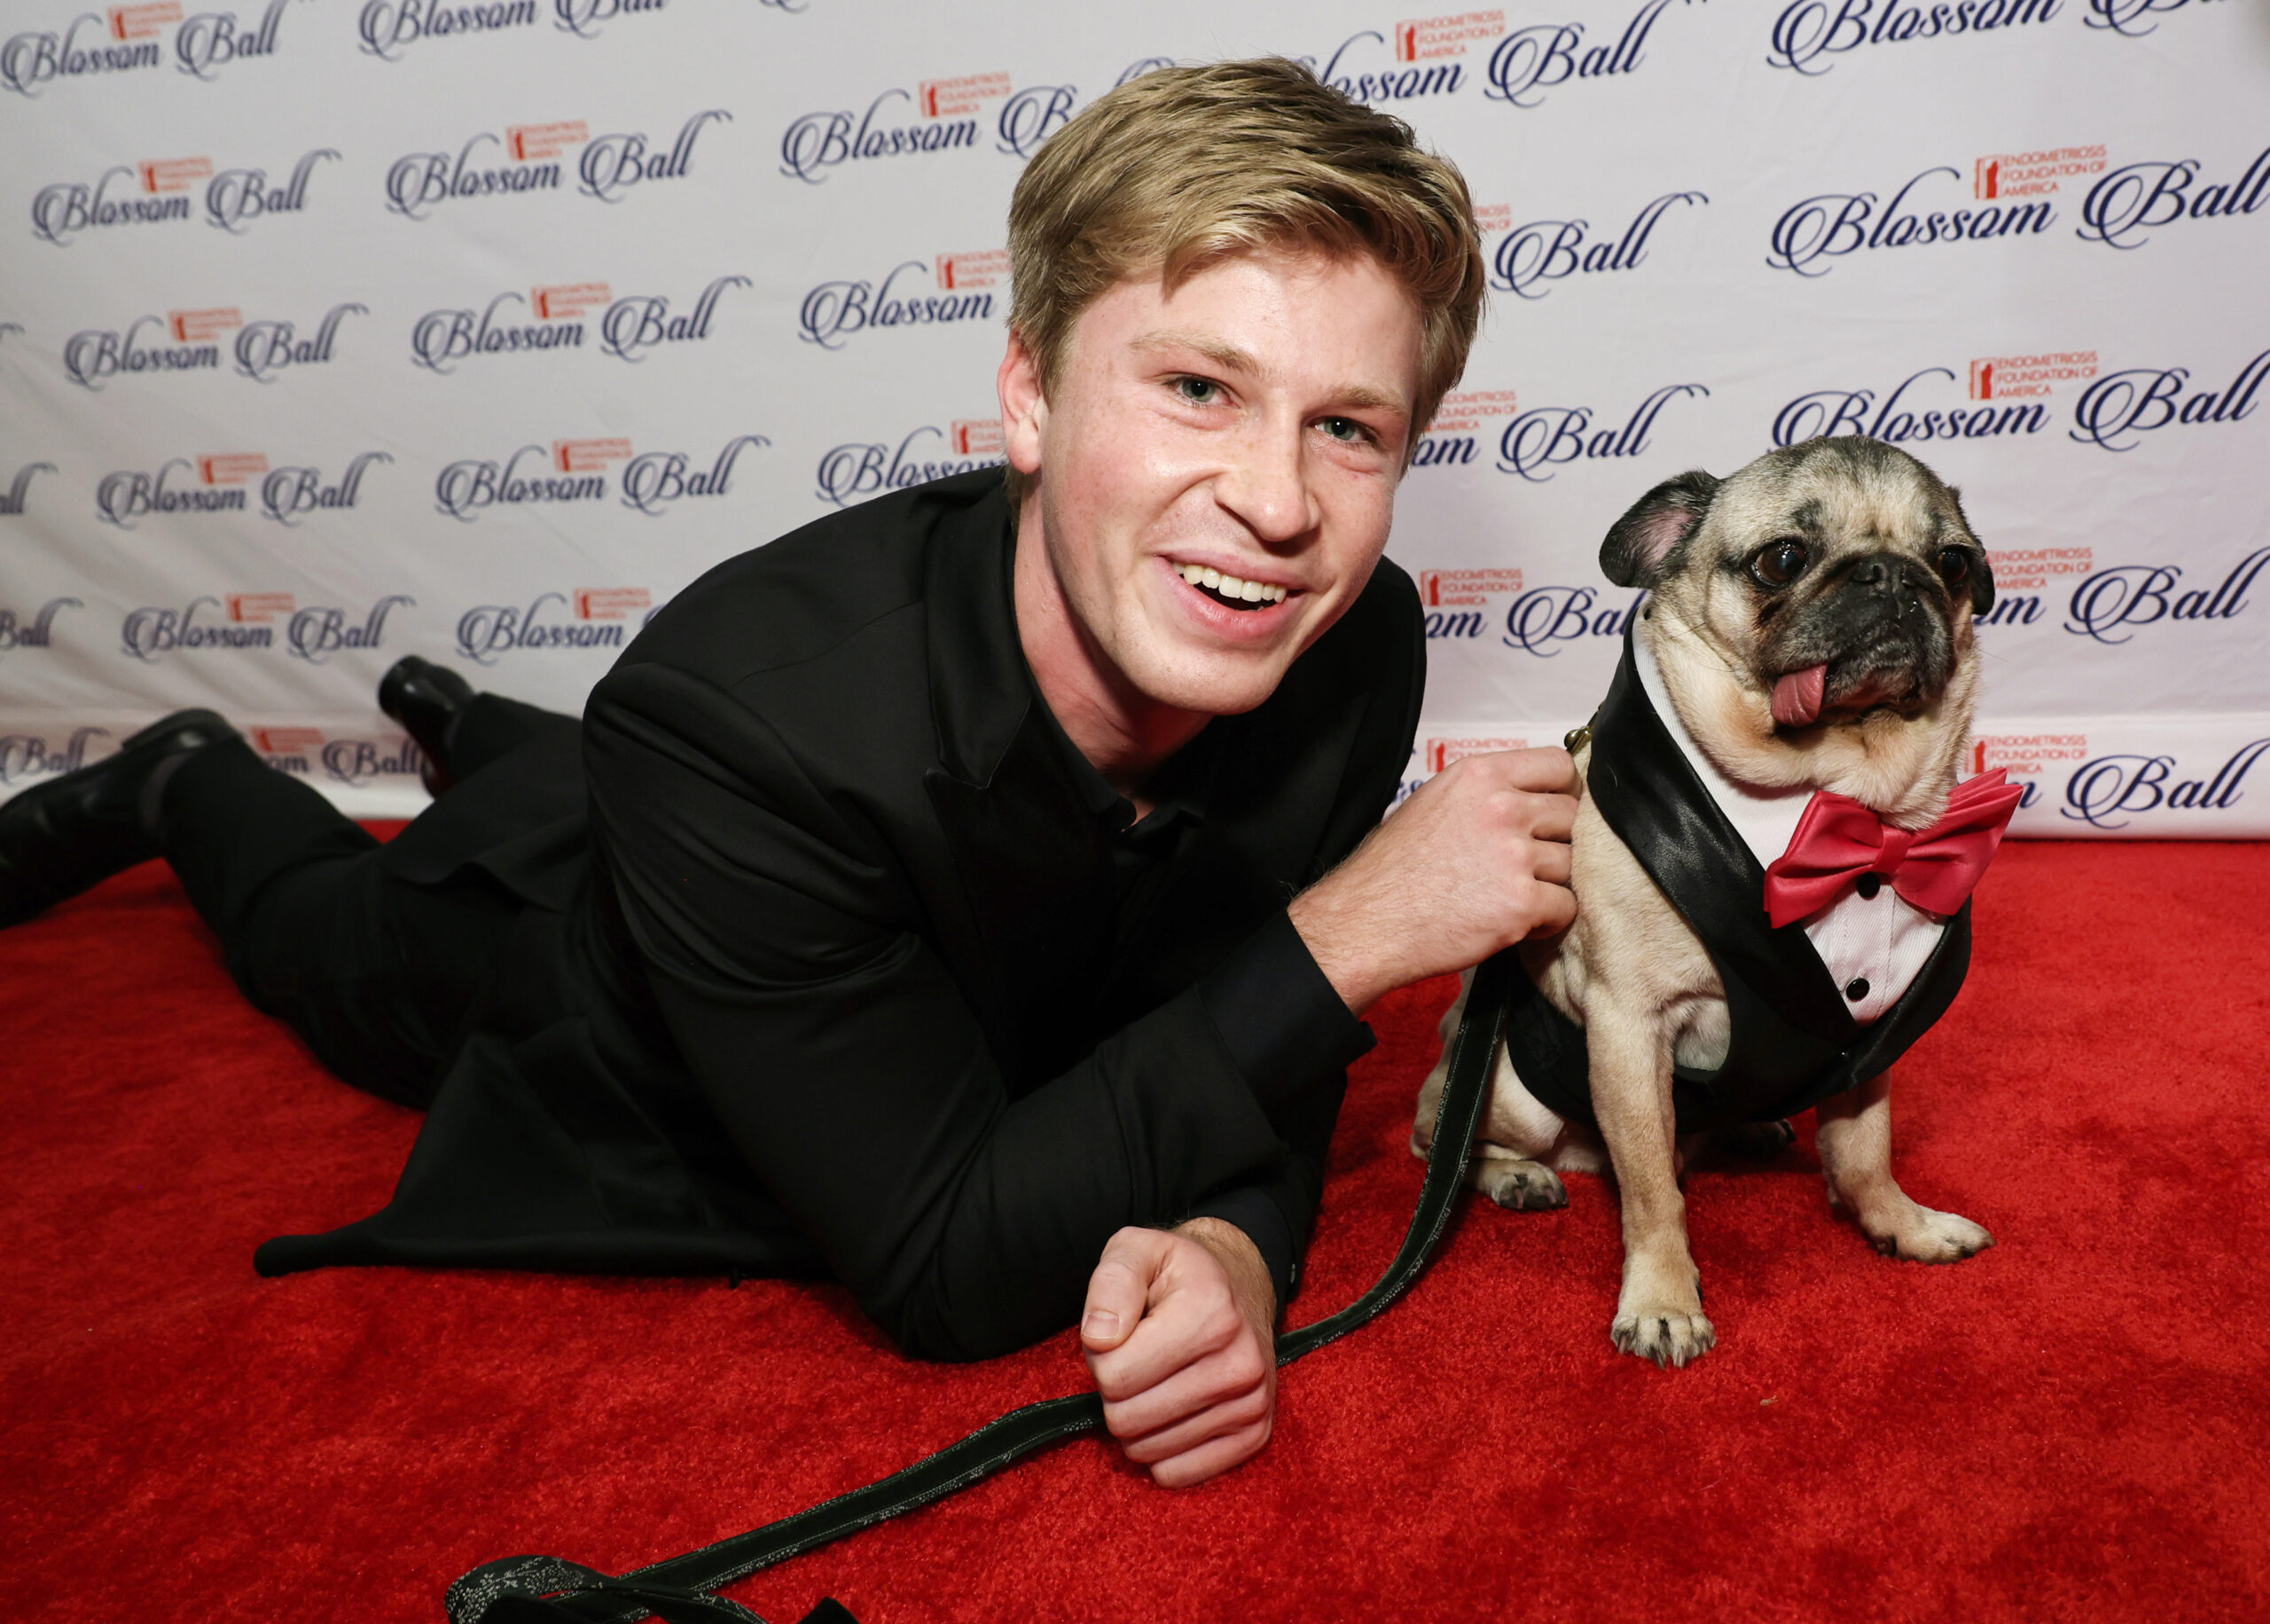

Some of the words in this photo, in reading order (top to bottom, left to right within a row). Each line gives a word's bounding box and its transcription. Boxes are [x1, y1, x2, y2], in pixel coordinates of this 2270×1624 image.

[0, 12, 160, 98] Blossom
[175, 0, 291, 82] Ball
[358, 0, 536, 62] Blossom
[1297, 31, 1466, 105] lossom
[1484, 0, 1672, 107] Ball
[1419, 26, 1489, 45] FOUNDATION
[1491, 22, 1506, 37] OF
[1421, 43, 1468, 59] AMERICA
[1766, 0, 2062, 75] Blossom
[385, 133, 560, 222] Blossom
[577, 109, 733, 204] Ball
[779, 89, 979, 184] Blossom
[2002, 163, 2086, 182] FOUNDATION
[2088, 160, 2108, 174] OF
[32, 166, 189, 247] Blossom
[206, 148, 342, 236] Ball
[1766, 167, 2057, 277] Blossom
[2076, 146, 2270, 249] Ball
[2004, 181, 2059, 197] AMERICA
[1491, 191, 1709, 299] Ball
[411, 292, 584, 375] Blossom
[600, 276, 753, 363] Ball
[798, 261, 998, 350] Blossom
[64, 315, 218, 392] Blossom
[233, 303, 369, 384] Ball
[1996, 367, 2079, 384] FOUNDATION
[2080, 365, 2099, 379] OF
[1436, 418, 1480, 432] AMERICA
[1773, 368, 2050, 445] Blossom
[2069, 349, 2270, 452] Ball
[1998, 384, 2053, 398] AMERICA
[1496, 385, 1710, 482] Ball
[96, 458, 246, 530] Blossom
[261, 451, 395, 527] Ball
[435, 445, 606, 523] Blossom
[621, 435, 771, 517] Ball
[1443, 595, 1489, 606] AMERICA
[1993, 561, 2075, 577] FOUNDATION
[2076, 559, 2093, 574] OF
[1995, 576, 2047, 590] AMERICA
[2063, 546, 2270, 644] Ball
[121, 596, 271, 665] Blossom
[287, 595, 417, 665] Ball
[456, 592, 623, 667] Blossom
[1504, 586, 1648, 658] Bal
[0, 727, 111, 787] Ball
[321, 738, 422, 788] Ball
[1989, 748, 2070, 761] FOUNDATION
[2070, 747, 2087, 761] OF
[2060, 738, 2270, 829] Ball
